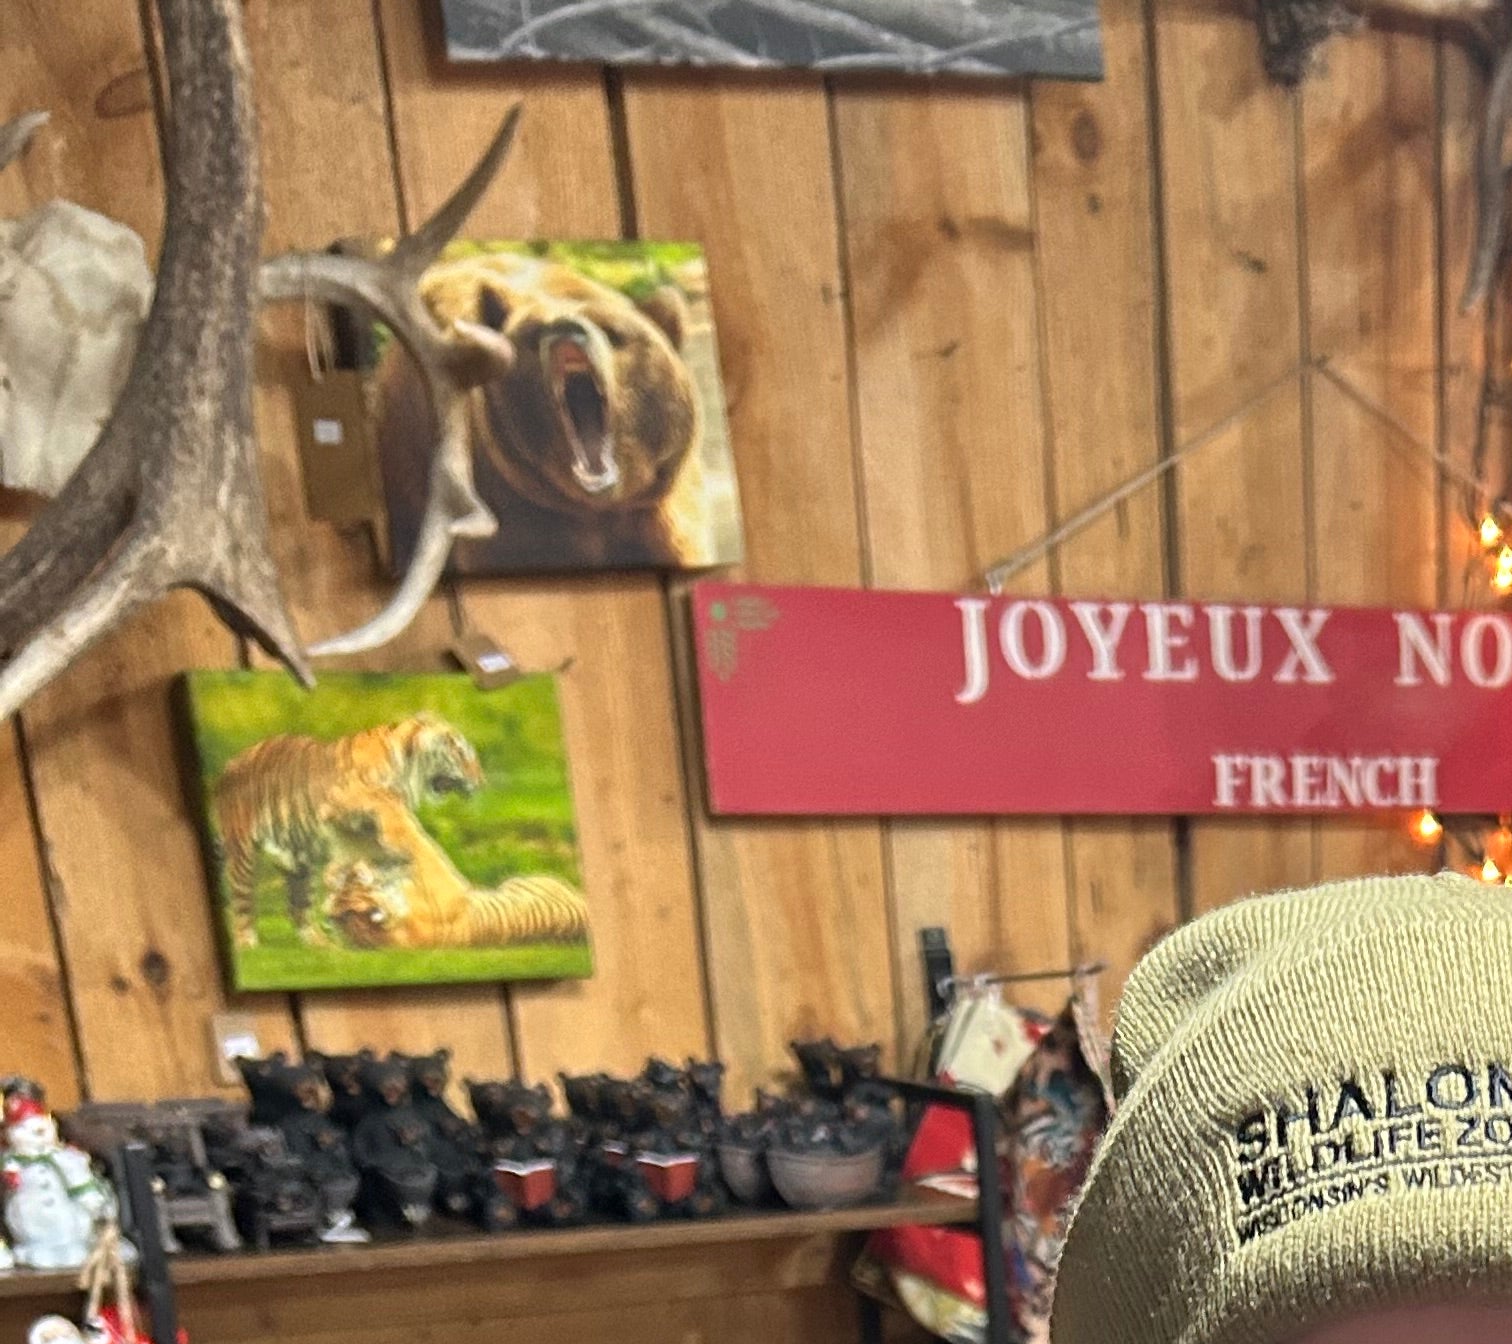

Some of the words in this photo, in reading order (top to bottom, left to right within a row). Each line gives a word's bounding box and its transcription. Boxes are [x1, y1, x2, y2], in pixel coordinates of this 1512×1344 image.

[953, 597, 1334, 704] JOYEUX
[1212, 755, 1439, 808] FRENCH
[1237, 1118, 1441, 1204] WILDLIFE
